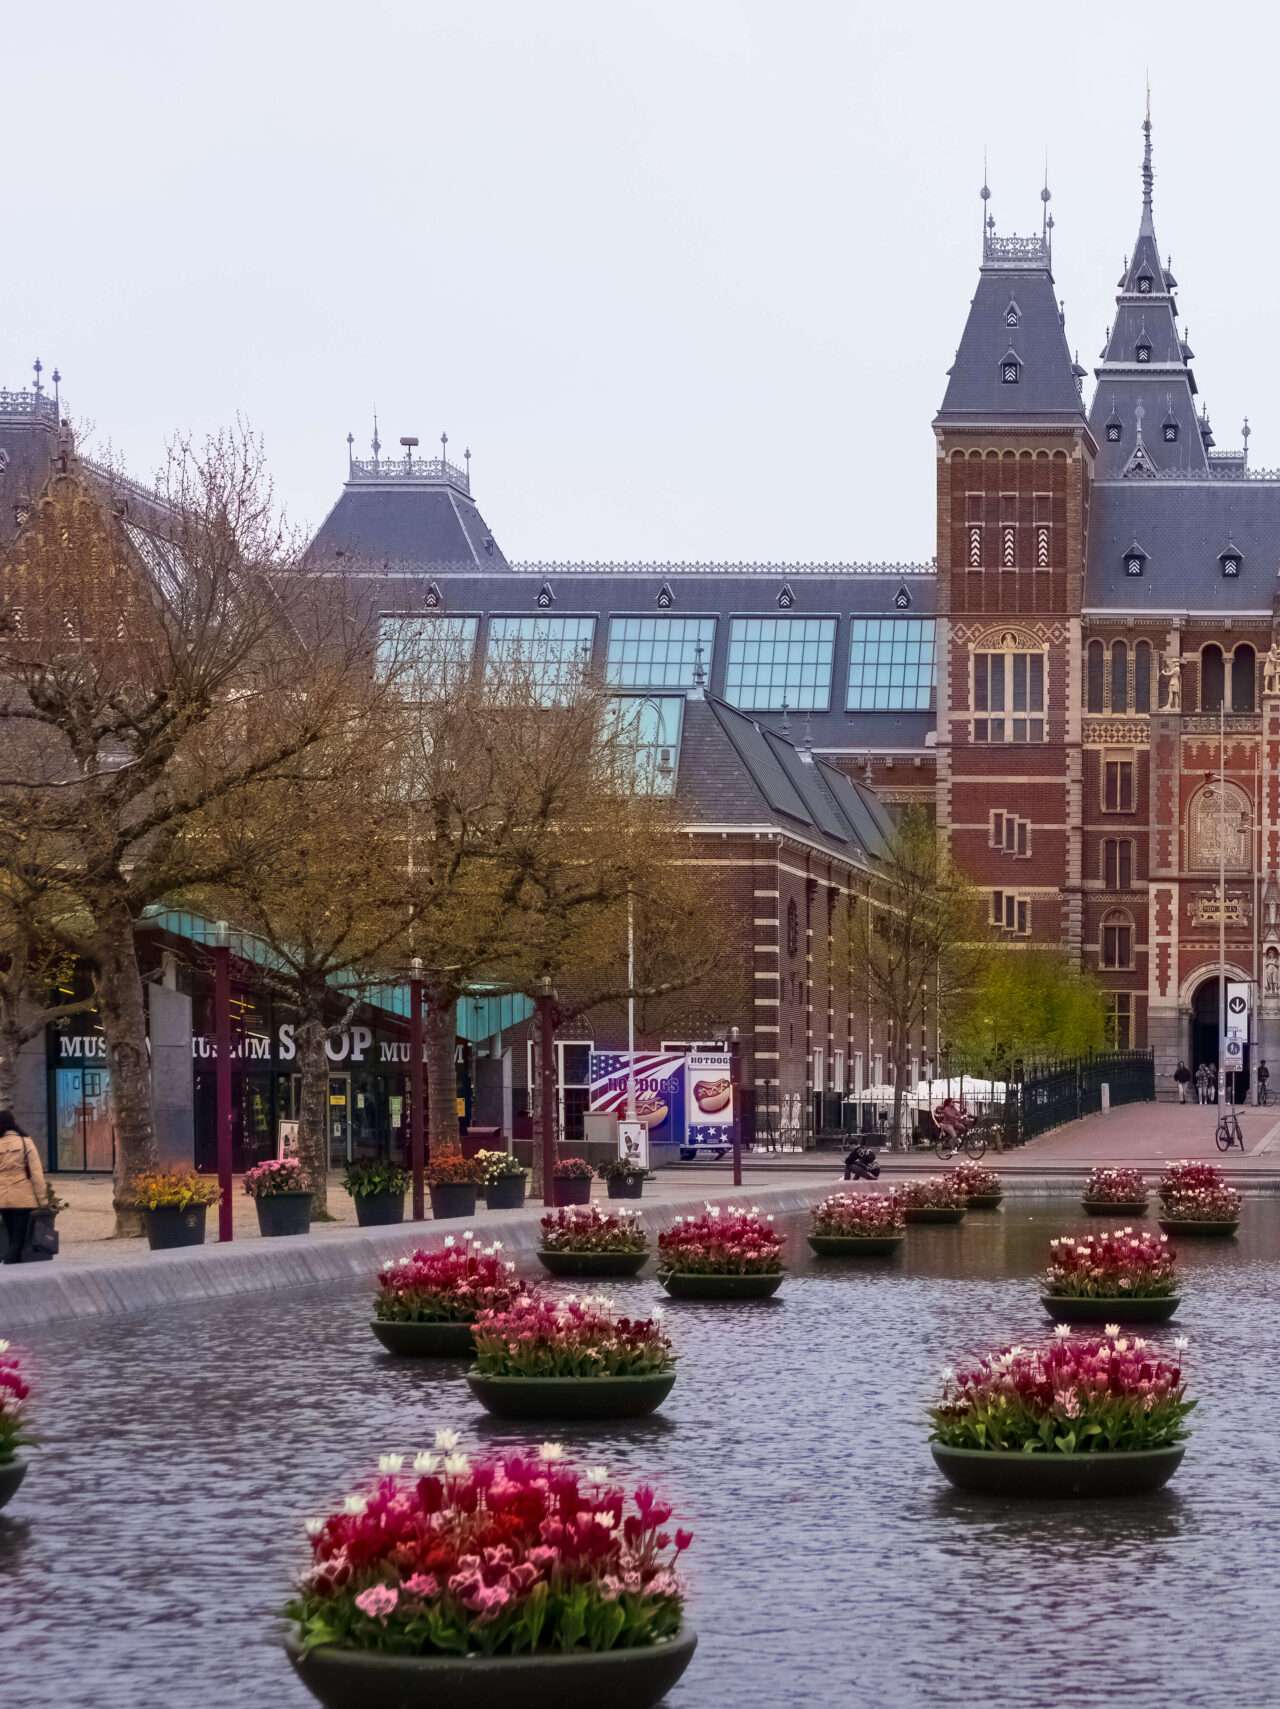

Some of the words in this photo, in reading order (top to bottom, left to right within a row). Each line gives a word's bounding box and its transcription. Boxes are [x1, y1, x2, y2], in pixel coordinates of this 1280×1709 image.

[279, 1023, 372, 1061] SOP
[690, 1056, 730, 1065] HOTDOG
[608, 1077, 680, 1093] HODOGS
